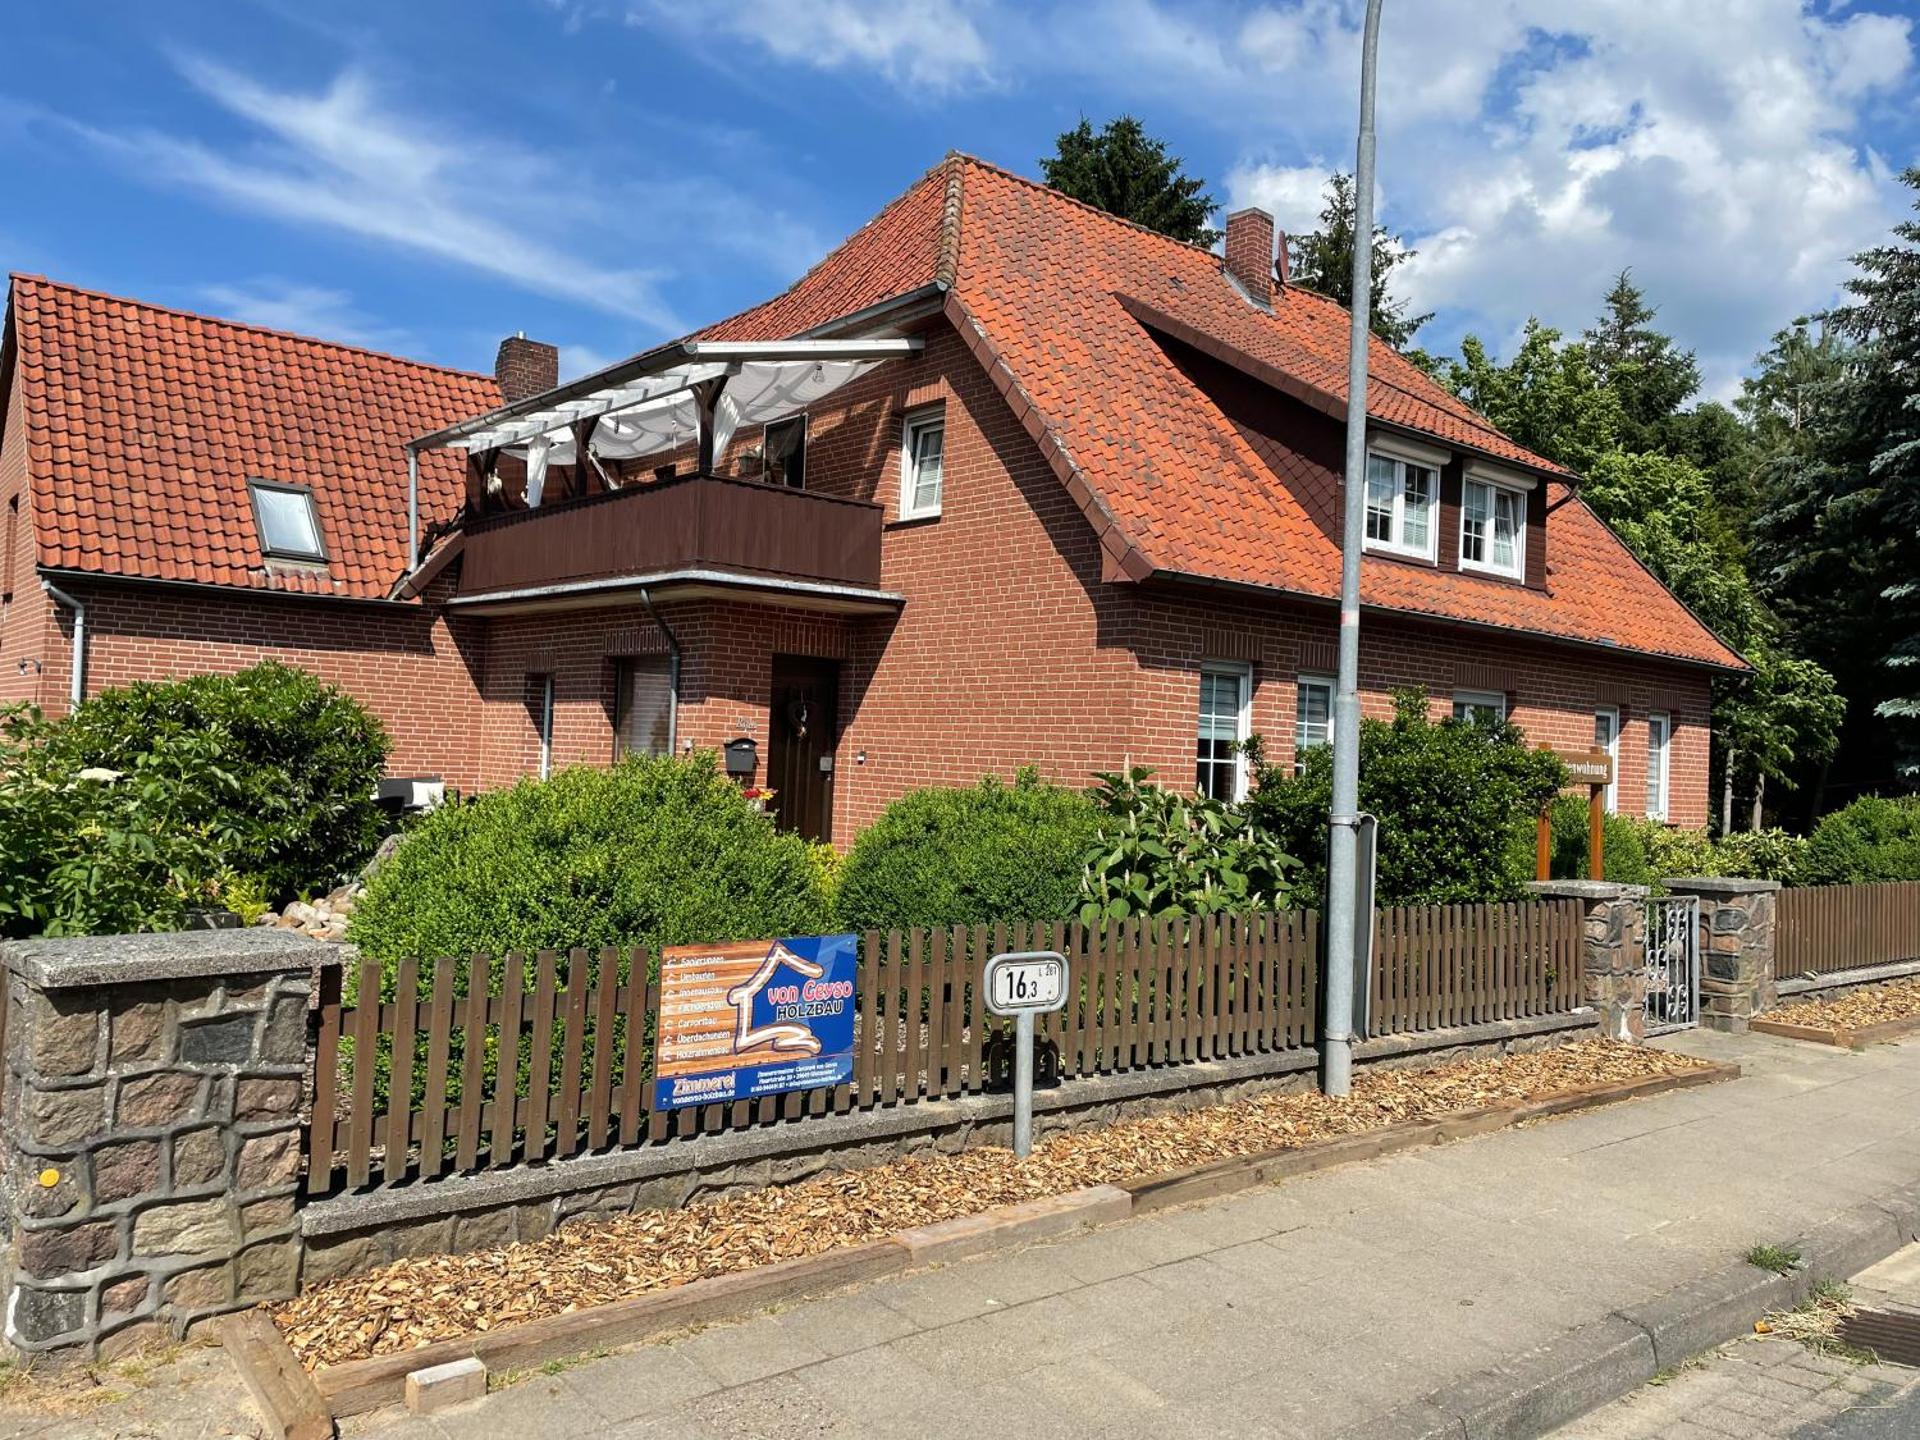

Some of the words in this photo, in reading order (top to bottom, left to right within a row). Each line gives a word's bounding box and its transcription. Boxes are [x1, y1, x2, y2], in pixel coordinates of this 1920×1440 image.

[767, 985, 798, 1005] von
[802, 979, 853, 1001] Geyso
[776, 1000, 844, 1021] HOLZBAU
[673, 1071, 736, 1097] Zimmerei
